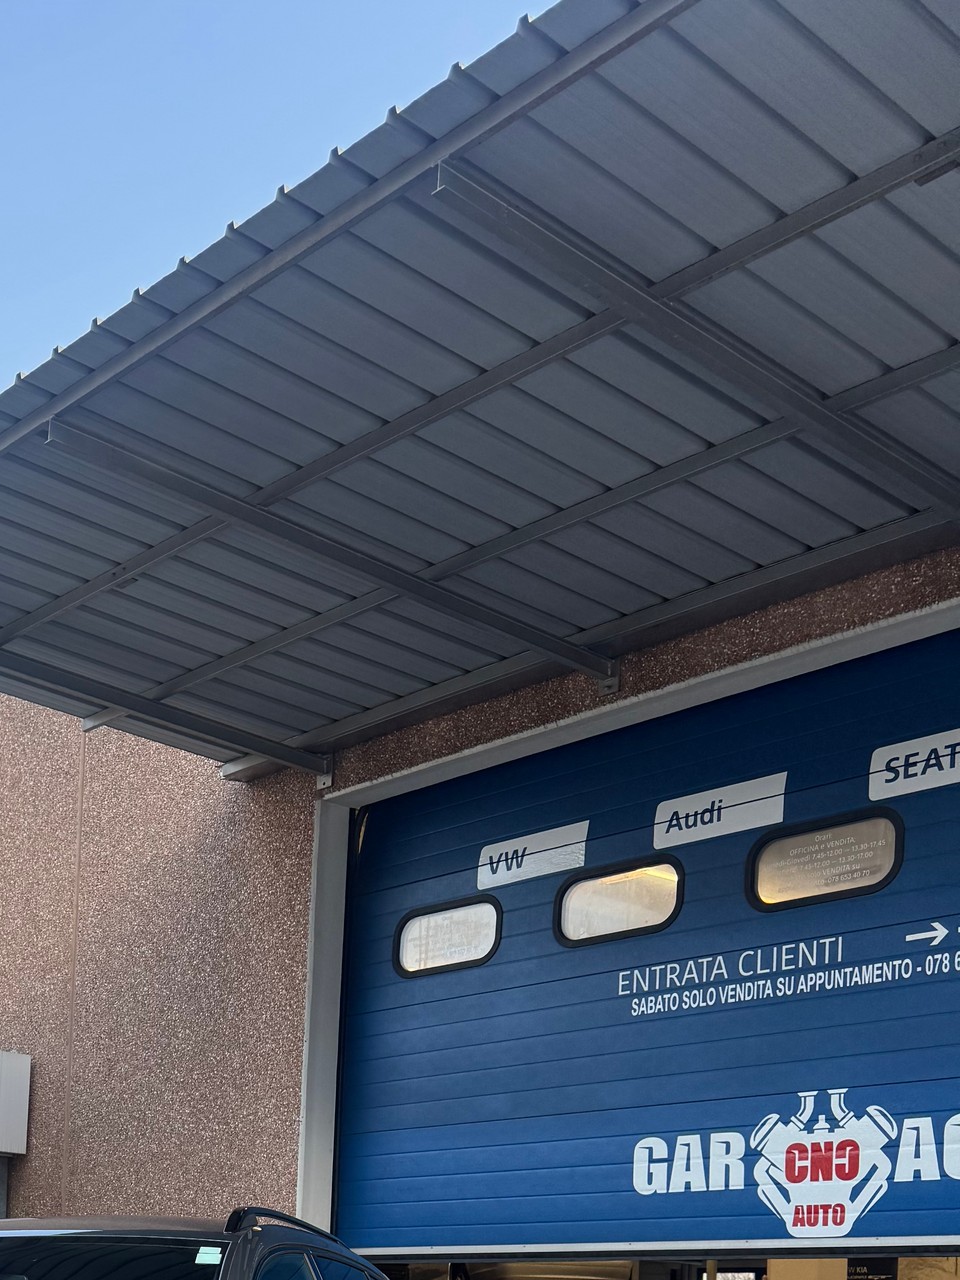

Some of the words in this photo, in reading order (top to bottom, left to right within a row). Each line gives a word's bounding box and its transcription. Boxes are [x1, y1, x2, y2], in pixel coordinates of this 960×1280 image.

[884, 742, 960, 784] SEAT
[665, 799, 723, 835] Audi
[489, 847, 528, 875] VW
[789, 845, 819, 856] OFFICINA
[618, 956, 728, 995] ENTRATA
[738, 937, 843, 977] CLIENTI
[631, 992, 679, 1016] SABATO
[682, 986, 716, 1010] SOLO
[719, 979, 773, 1004] VENDITA
[776, 976, 795, 997] SU
[797, 959, 912, 994] APPUNTAMENTO
[925, 952, 950, 976] 078
[633, 1132, 745, 1196] GAR
[792, 1203, 846, 1228] AUTO
